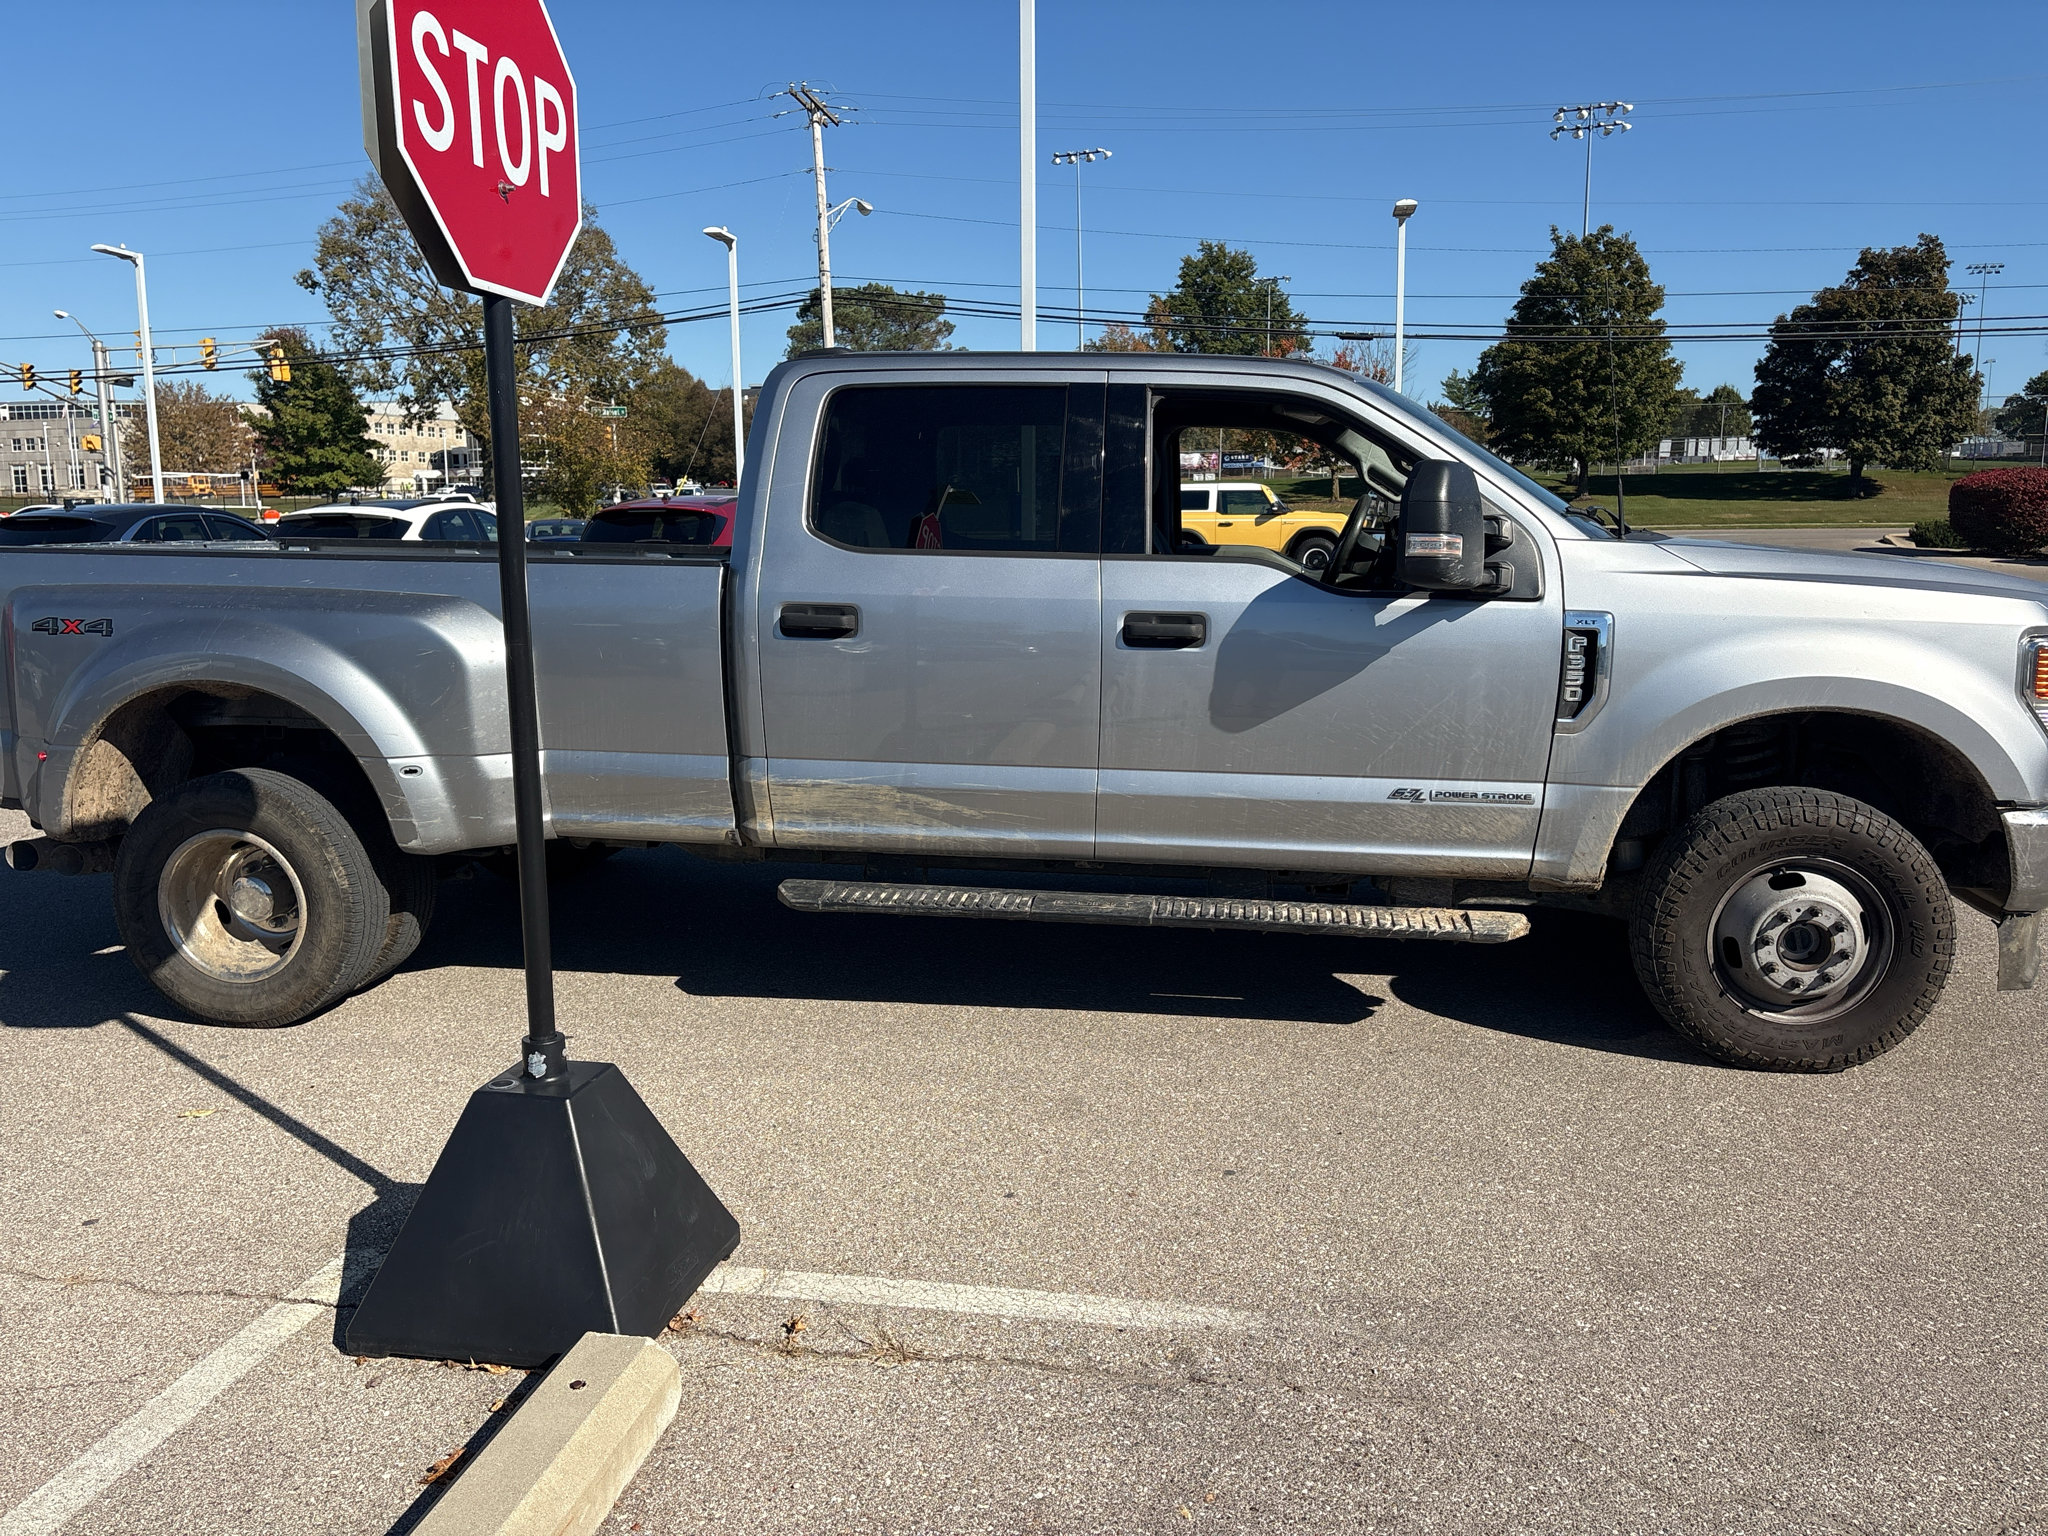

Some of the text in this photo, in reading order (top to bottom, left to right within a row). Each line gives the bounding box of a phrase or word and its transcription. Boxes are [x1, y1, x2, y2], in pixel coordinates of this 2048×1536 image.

[411, 10, 567, 198] STOP
[1434, 791, 1479, 799] POWER
[1481, 791, 1533, 800] STROKE
[1716, 834, 1848, 880] COURSER
[1857, 848, 1917, 909] TRAIL
